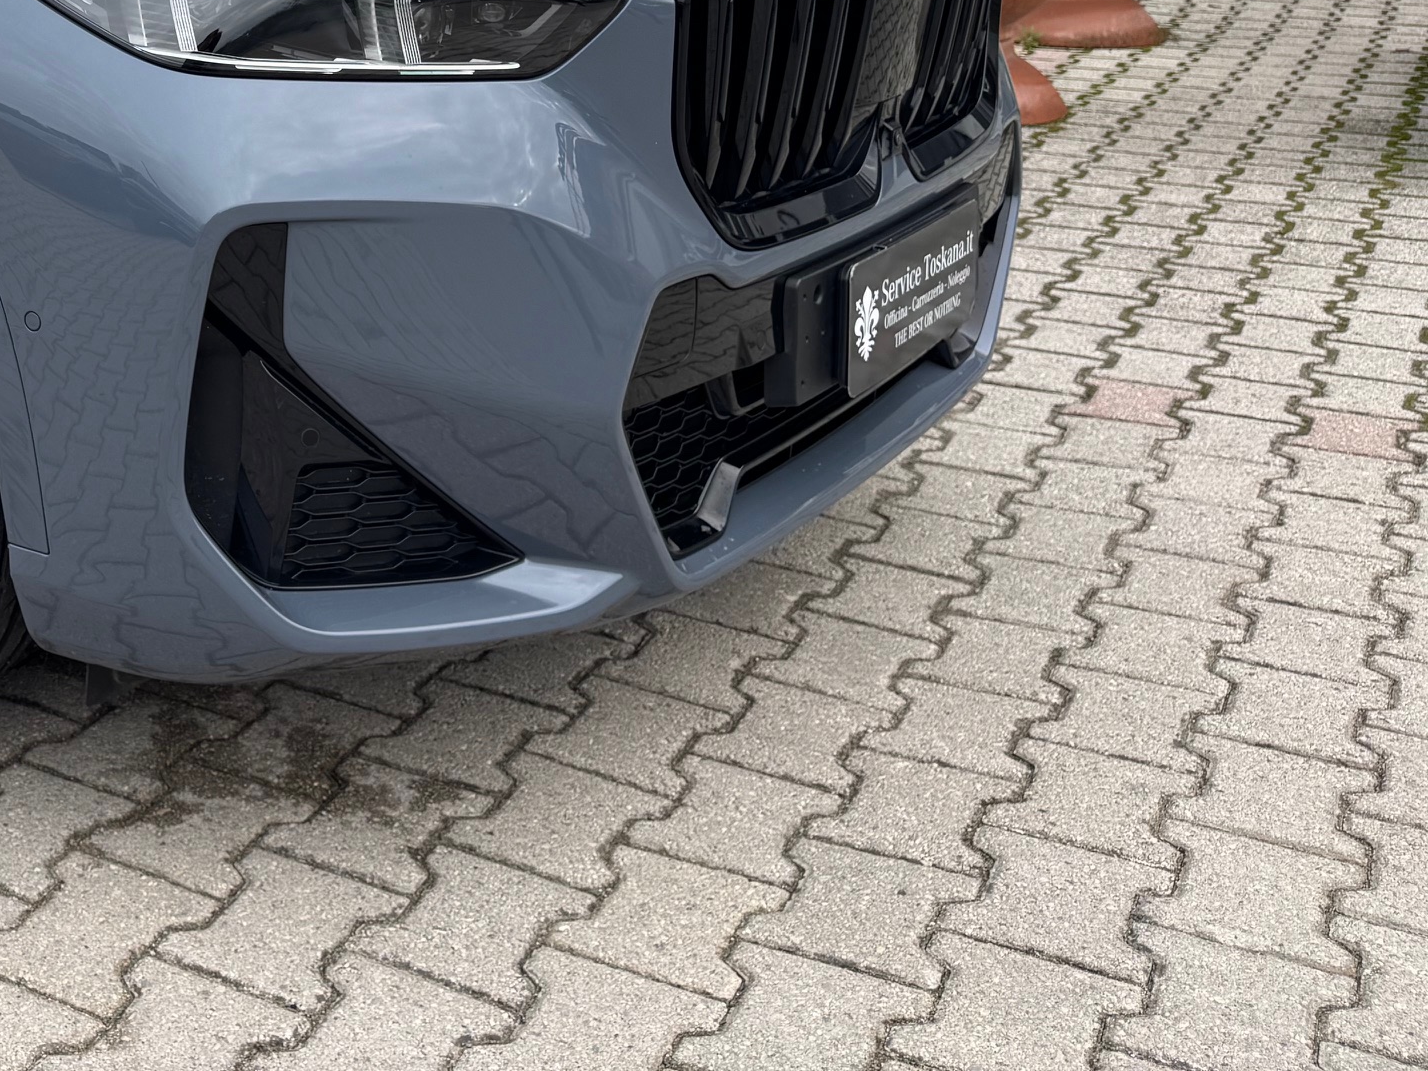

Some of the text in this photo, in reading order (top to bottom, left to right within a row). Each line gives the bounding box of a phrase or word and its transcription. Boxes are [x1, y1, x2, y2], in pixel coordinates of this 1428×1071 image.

[881, 230, 974, 307] Service Toskana.it
[884, 305, 908, 329] Officina
[912, 281, 944, 312] Carrozzeria
[947, 264, 971, 289] Noleggio
[894, 292, 961, 348] THE BEST OR NOTHING
